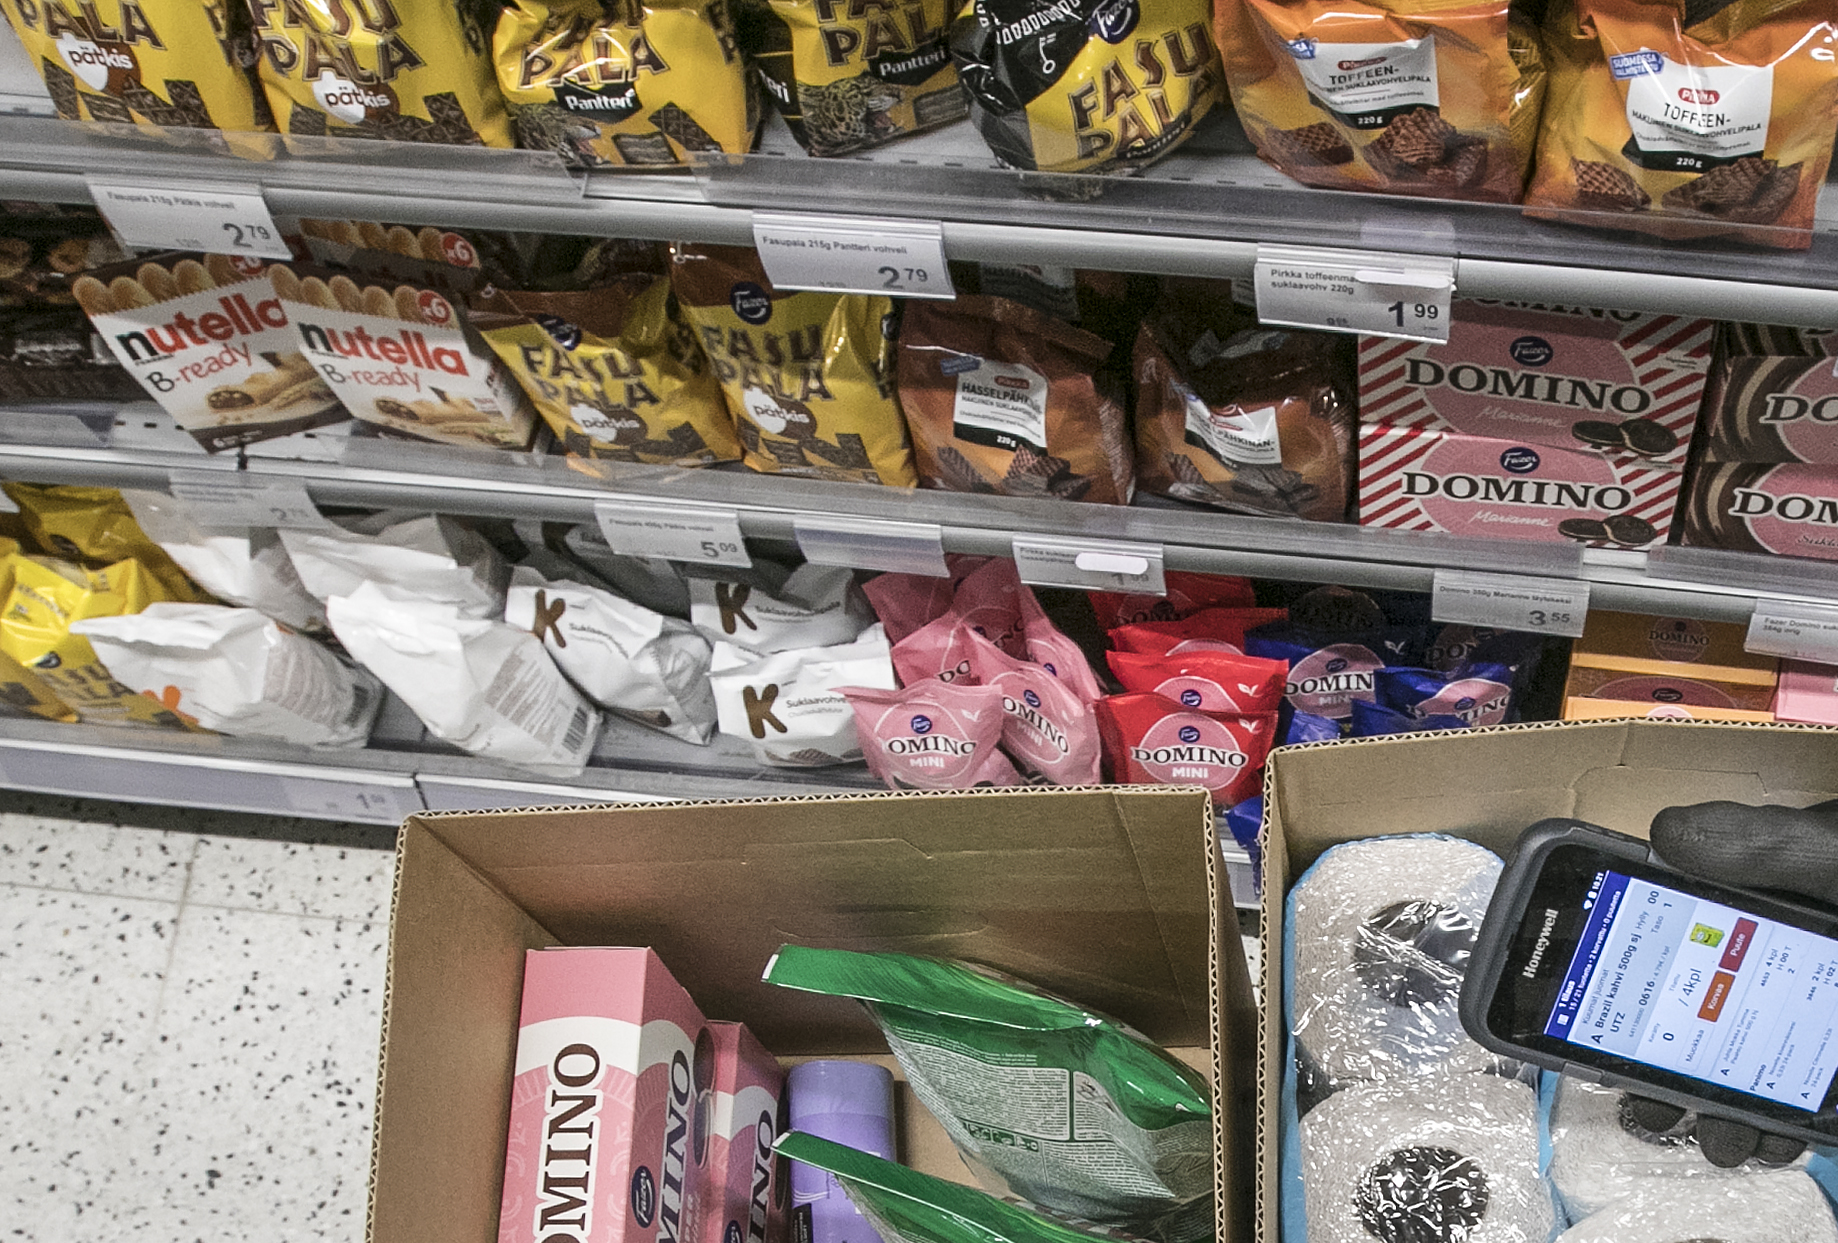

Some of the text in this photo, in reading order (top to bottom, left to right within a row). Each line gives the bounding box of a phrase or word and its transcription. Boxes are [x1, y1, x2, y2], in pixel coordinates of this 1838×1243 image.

[69, 46, 134, 70] pätkis
[264, 36, 427, 83] PALA
[519, 31, 668, 89] PALA
[879, 50, 946, 77] Pantteri
[1068, 22, 1215, 131] FASU
[1329, 65, 1400, 85] TOFFEEN-
[325, 87, 411, 108] pätkis
[565, 92, 635, 111] Pantteri
[1357, 116, 1375, 125] 220
[1664, 103, 1731, 127] TOFFEEN-
[1676, 157, 1695, 166] 220
[223, 223, 270, 247] 2 79
[763, 236, 806, 248] Fasupala
[834, 241, 871, 252] Pantteri
[878, 267, 928, 290] 2 79
[1271, 269, 1302, 279] Pirkka
[1331, 285, 1355, 295] 220g
[1388, 301, 1404, 327] 1
[1414, 304, 1439, 319] 99
[117, 293, 288, 361] nutella
[299, 322, 469, 377] nutella
[1513, 342, 1550, 360] Fazer
[147, 343, 253, 392] B-ready
[320, 364, 420, 392] B-ready
[1405, 357, 1651, 414] DOMINO
[754, 404, 809, 423] pätkis
[1481, 405, 1567, 428] Marianne
[1504, 453, 1539, 469] Fazer
[1402, 472, 1632, 511] DOMINO
[1473, 510, 1554, 528] Marianne
[701, 542, 719, 558] 5
[535, 589, 566, 648] K
[716, 583, 757, 634] K
[1528, 610, 1570, 626] 3 55
[1649, 630, 1711, 647] DOMINO
[1285, 673, 1375, 695] DOMIN
[744, 684, 787, 739] K
[909, 757, 944, 768] MINI
[1134, 749, 1246, 767] DOMINO
[1172, 768, 1208, 778] MINI
[1635, 890, 1659, 930] Hylly 00
[1650, 914, 1664, 934] Taso
[1522, 907, 1561, 979] Honeywell
[1730, 932, 1745, 956] Puute
[1768, 948, 1778, 961] kpl
[1779, 951, 1789, 963] 00
[1815, 962, 1825, 975] kpl
[1593, 967, 1610, 995] juomat
[1594, 932, 1642, 1028] Brazil kahvi 500g sj
[1826, 966, 1835, 977] 02
[1638, 979, 1655, 1006] 0616
[1707, 982, 1724, 1010] Korvaa
[1662, 967, 1704, 1042] 0 4kpl
[1609, 1010, 1625, 1033] UTZ
[1590, 1031, 1603, 1044] A
[1720, 1066, 1729, 1076] A
[1749, 1063, 1767, 1092] Panimo
[1765, 1080, 1775, 1089] A
[1800, 1090, 1810, 1099] A
[636, 1168, 654, 1223] Fazer
